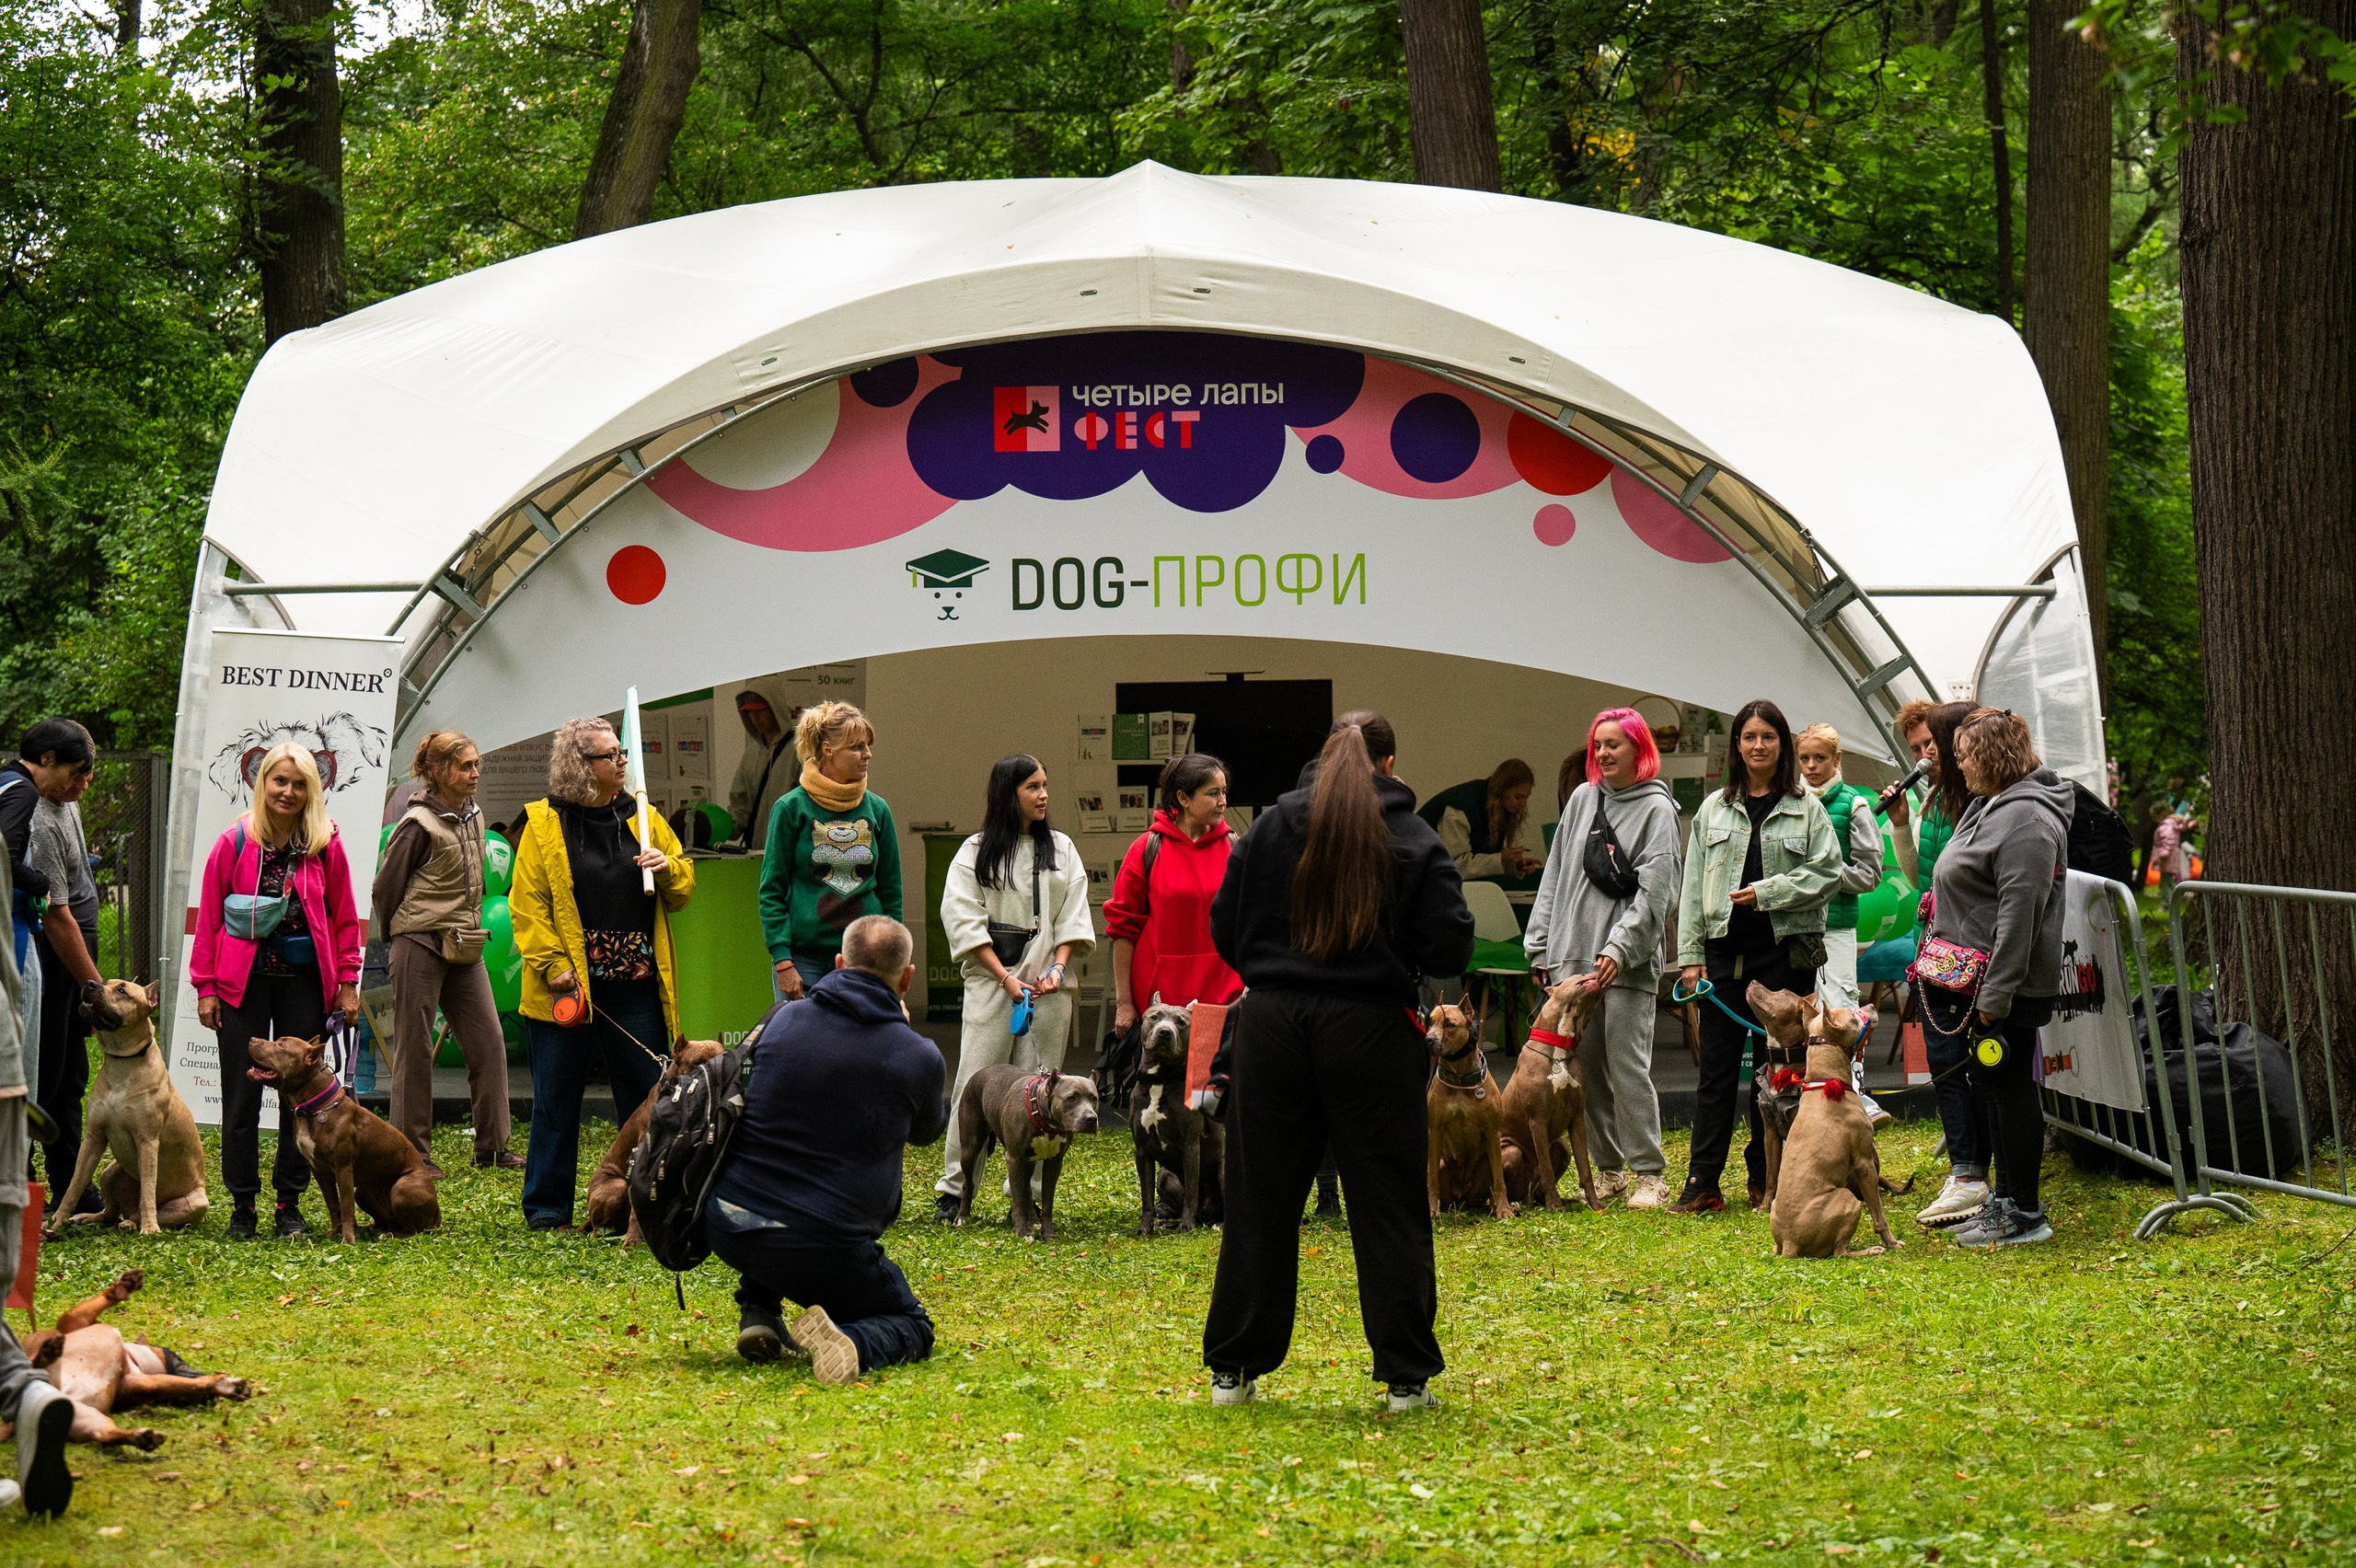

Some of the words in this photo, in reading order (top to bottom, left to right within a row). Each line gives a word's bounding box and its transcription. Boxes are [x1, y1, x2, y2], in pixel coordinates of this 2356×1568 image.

[1074, 410, 1200, 450] ФЕСТ
[1011, 552, 1366, 611] DOG-ПРОФИ
[221, 665, 283, 687] BEST
[287, 669, 385, 694] DINNER
[817, 674, 830, 685] 50
